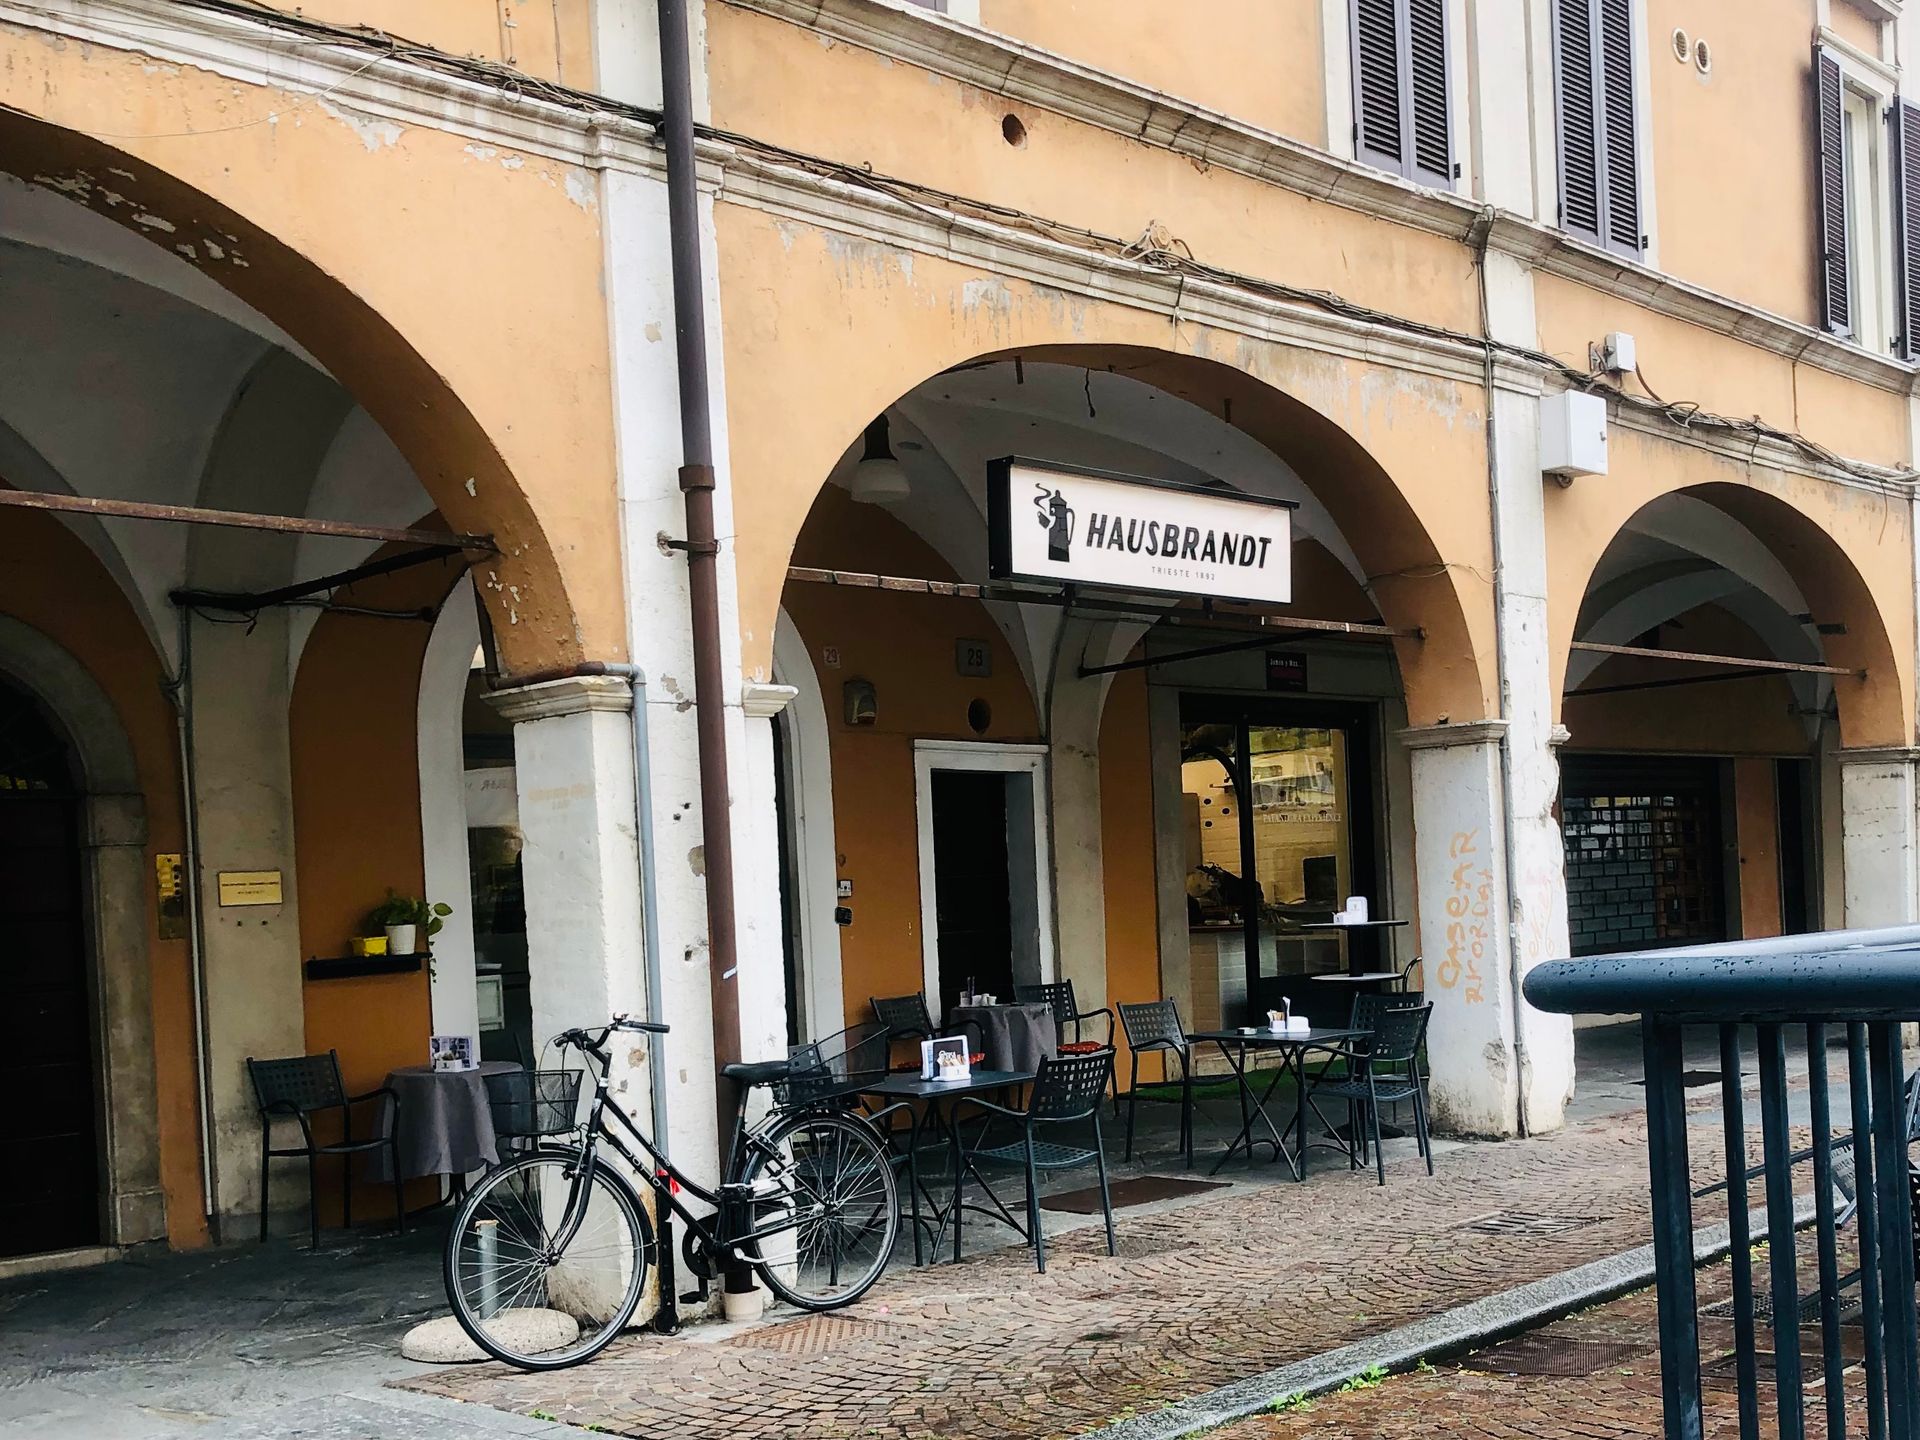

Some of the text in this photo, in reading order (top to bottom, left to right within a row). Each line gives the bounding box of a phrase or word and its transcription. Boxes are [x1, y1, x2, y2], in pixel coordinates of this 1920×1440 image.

[1086, 512, 1272, 569] HAUSBRANDT
[1151, 566, 1216, 581] TRIESTE 1892
